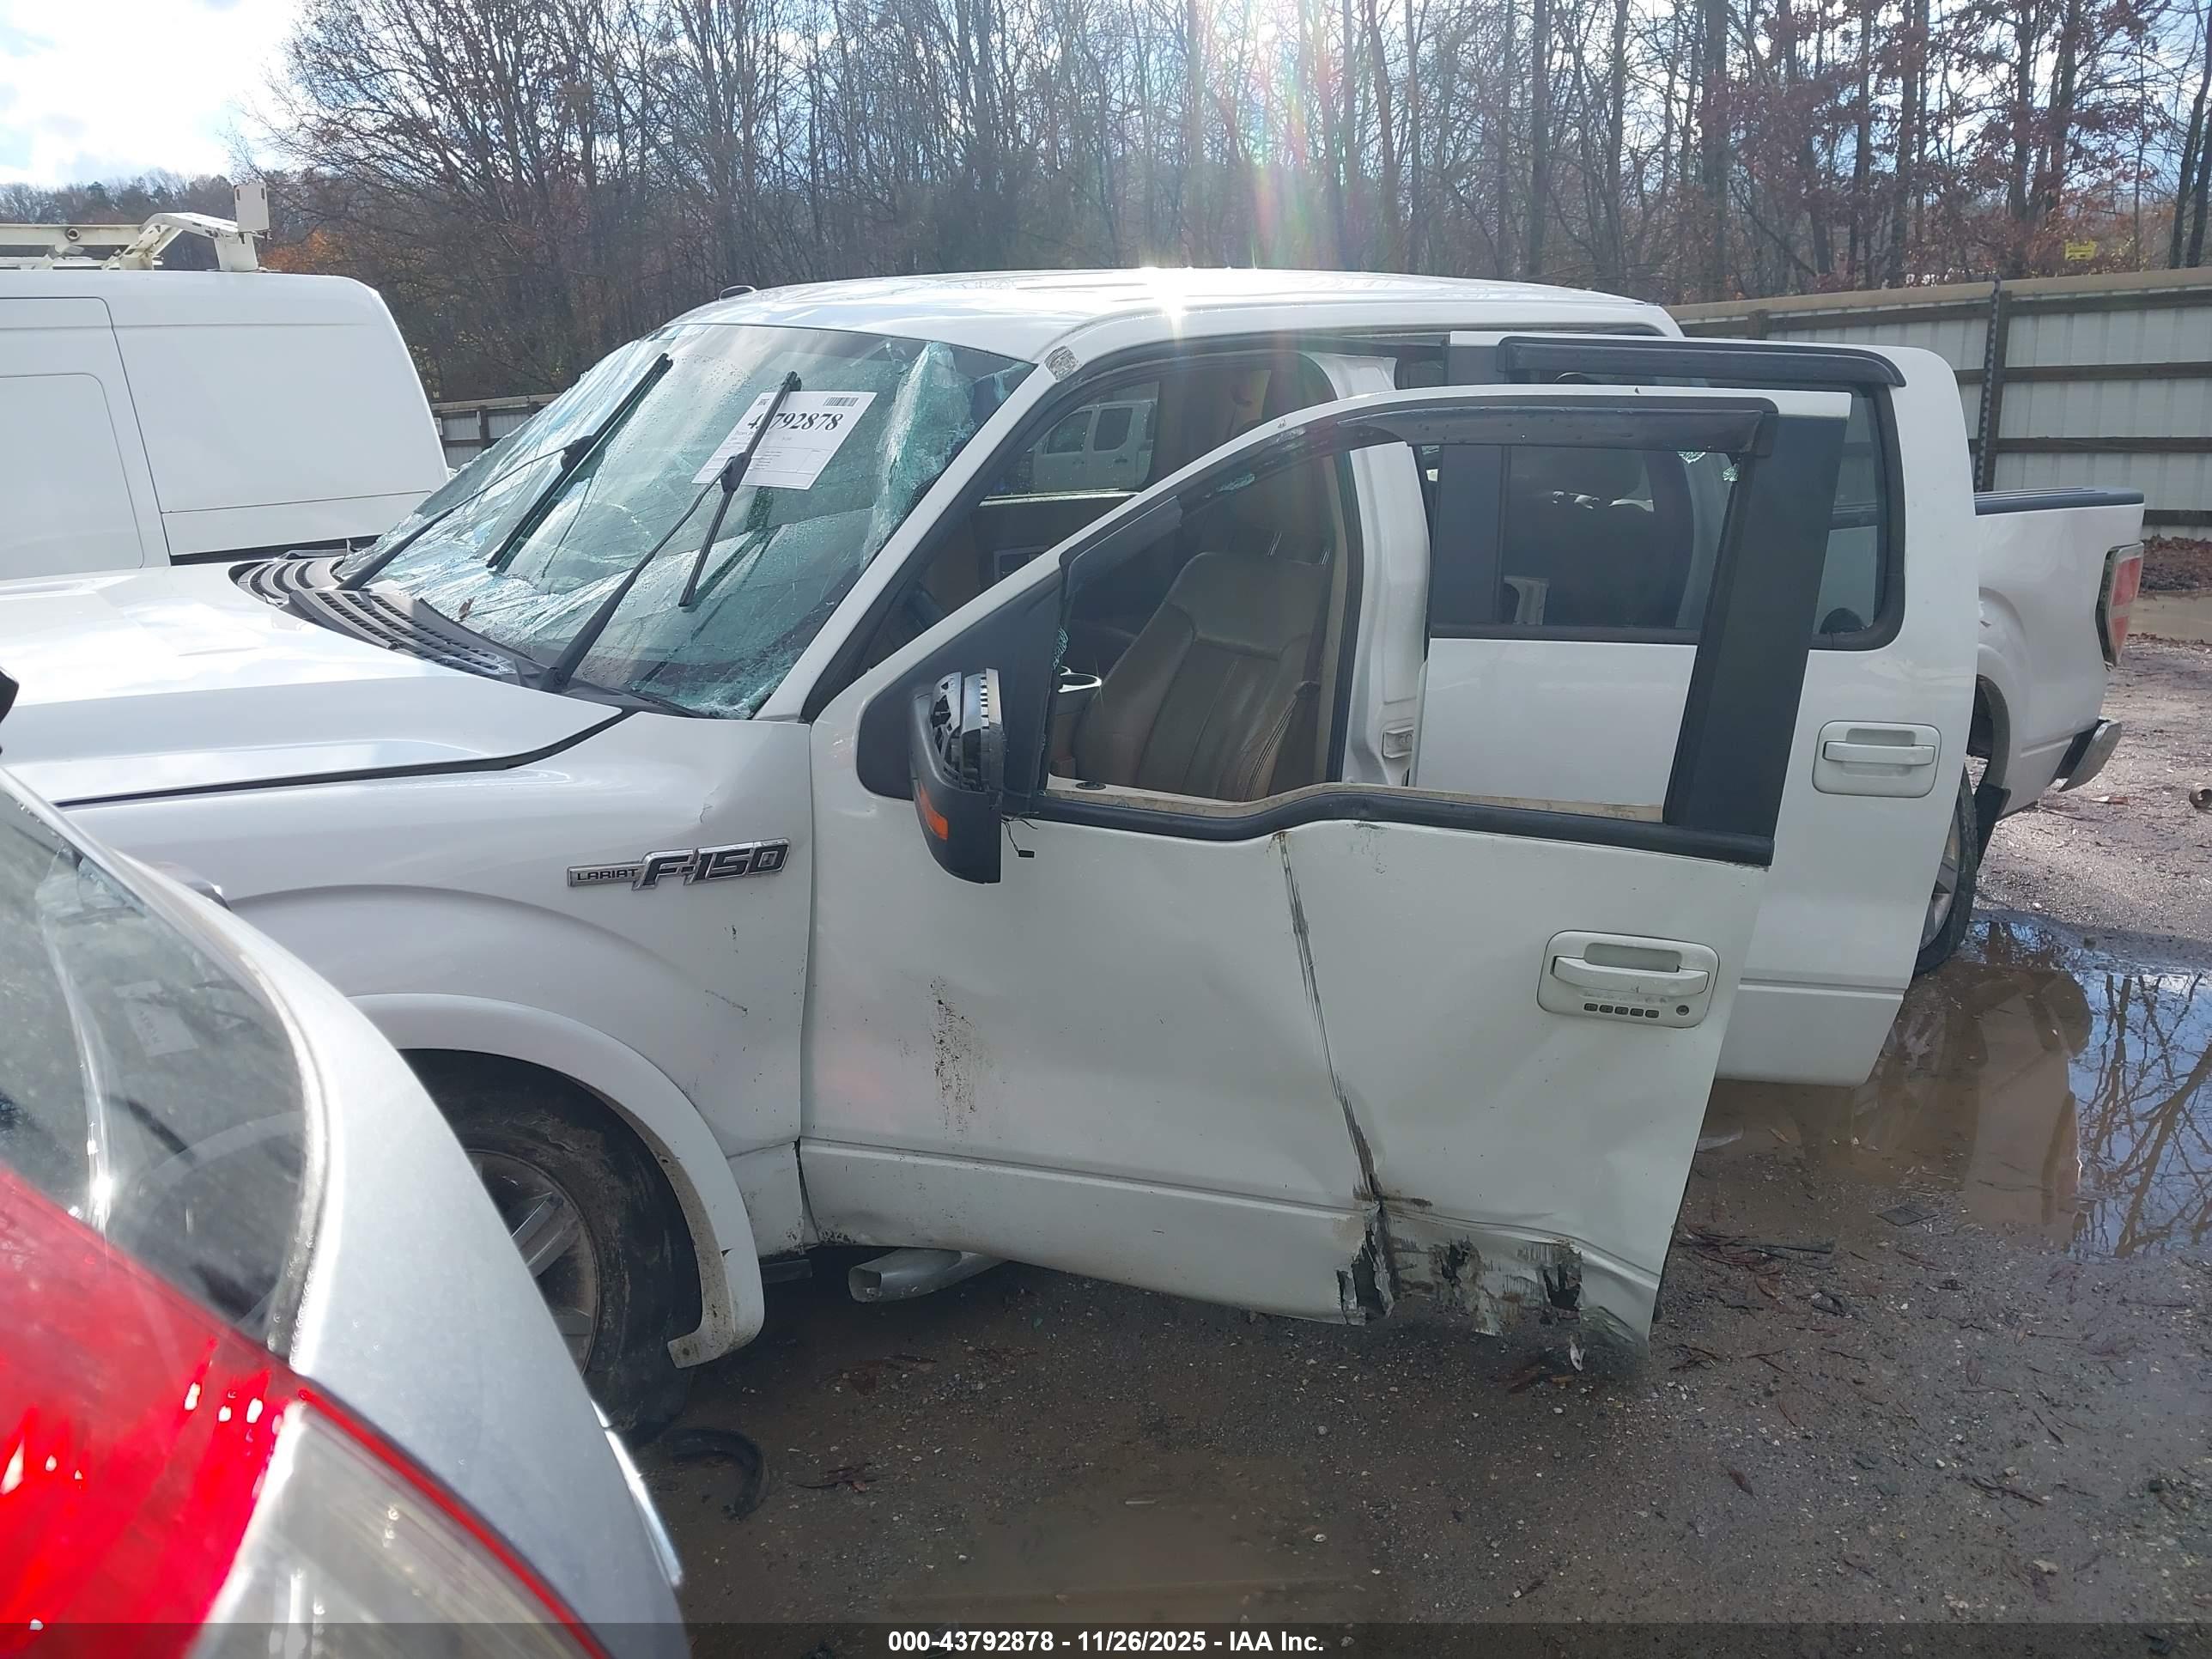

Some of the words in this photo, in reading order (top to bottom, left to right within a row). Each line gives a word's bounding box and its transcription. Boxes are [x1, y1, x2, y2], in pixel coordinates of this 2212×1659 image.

[747, 412, 844, 431] 4792878
[576, 867, 640, 882] LARIAT
[632, 837, 791, 891] F-150
